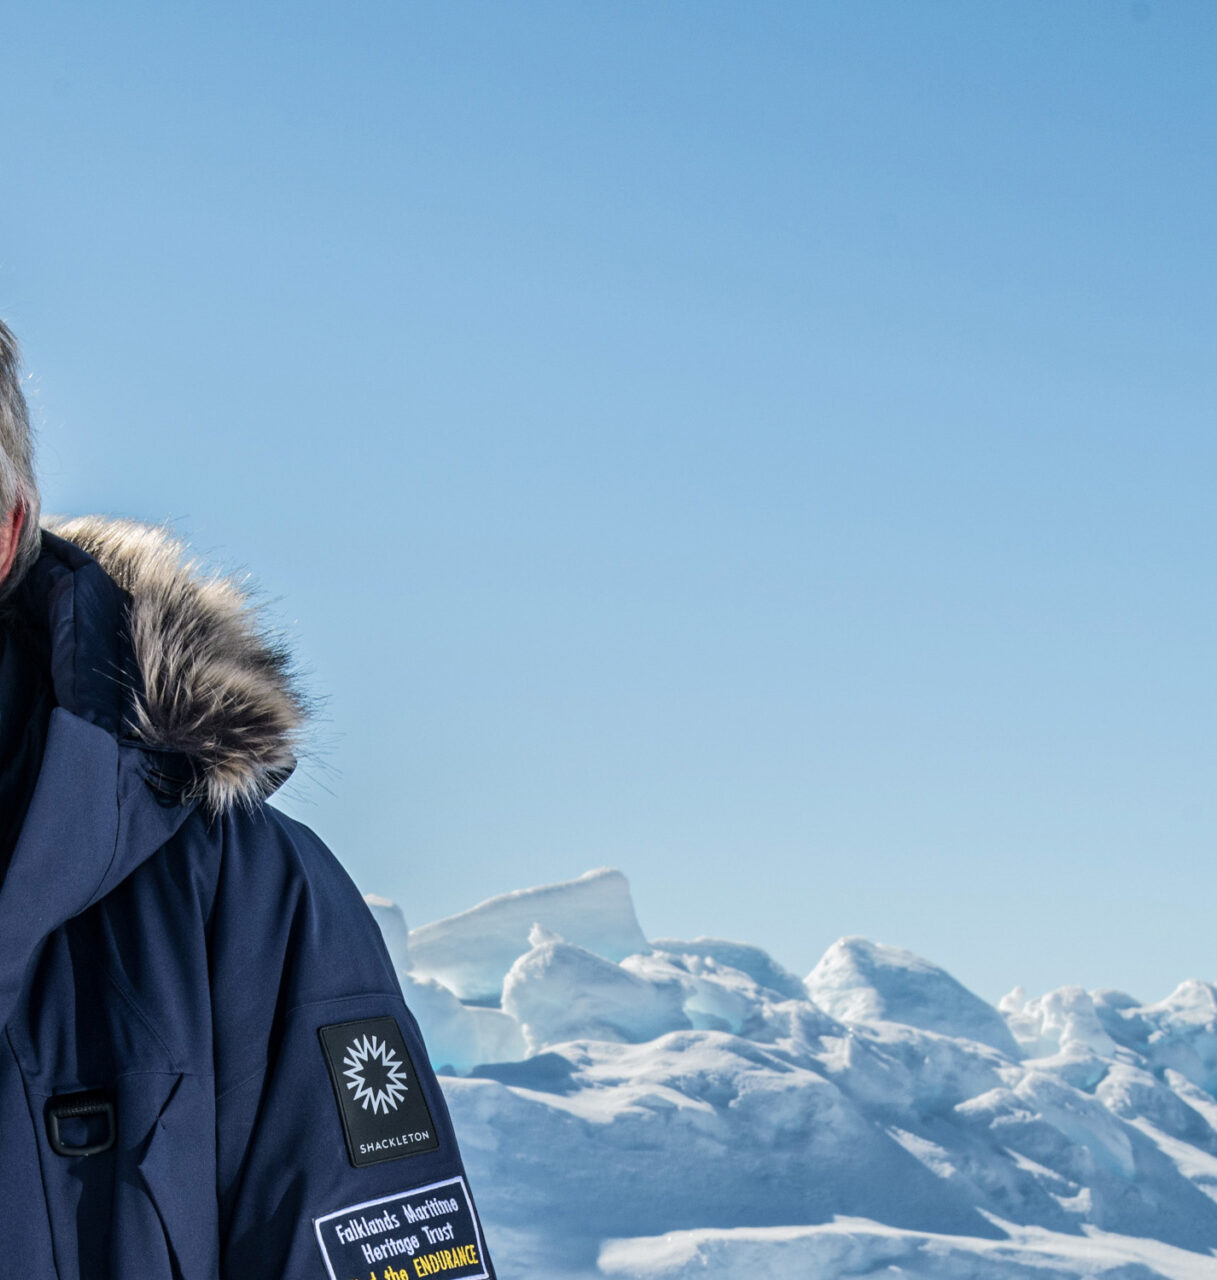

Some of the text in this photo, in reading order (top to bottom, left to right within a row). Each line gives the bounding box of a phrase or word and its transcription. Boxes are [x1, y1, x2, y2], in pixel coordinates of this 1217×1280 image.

[359, 1130, 430, 1154] SHACKLETON
[335, 1196, 459, 1245] Falklands Maritime
[361, 1222, 455, 1265] Heritage Trust
[413, 1244, 479, 1278] ENDURANCE
